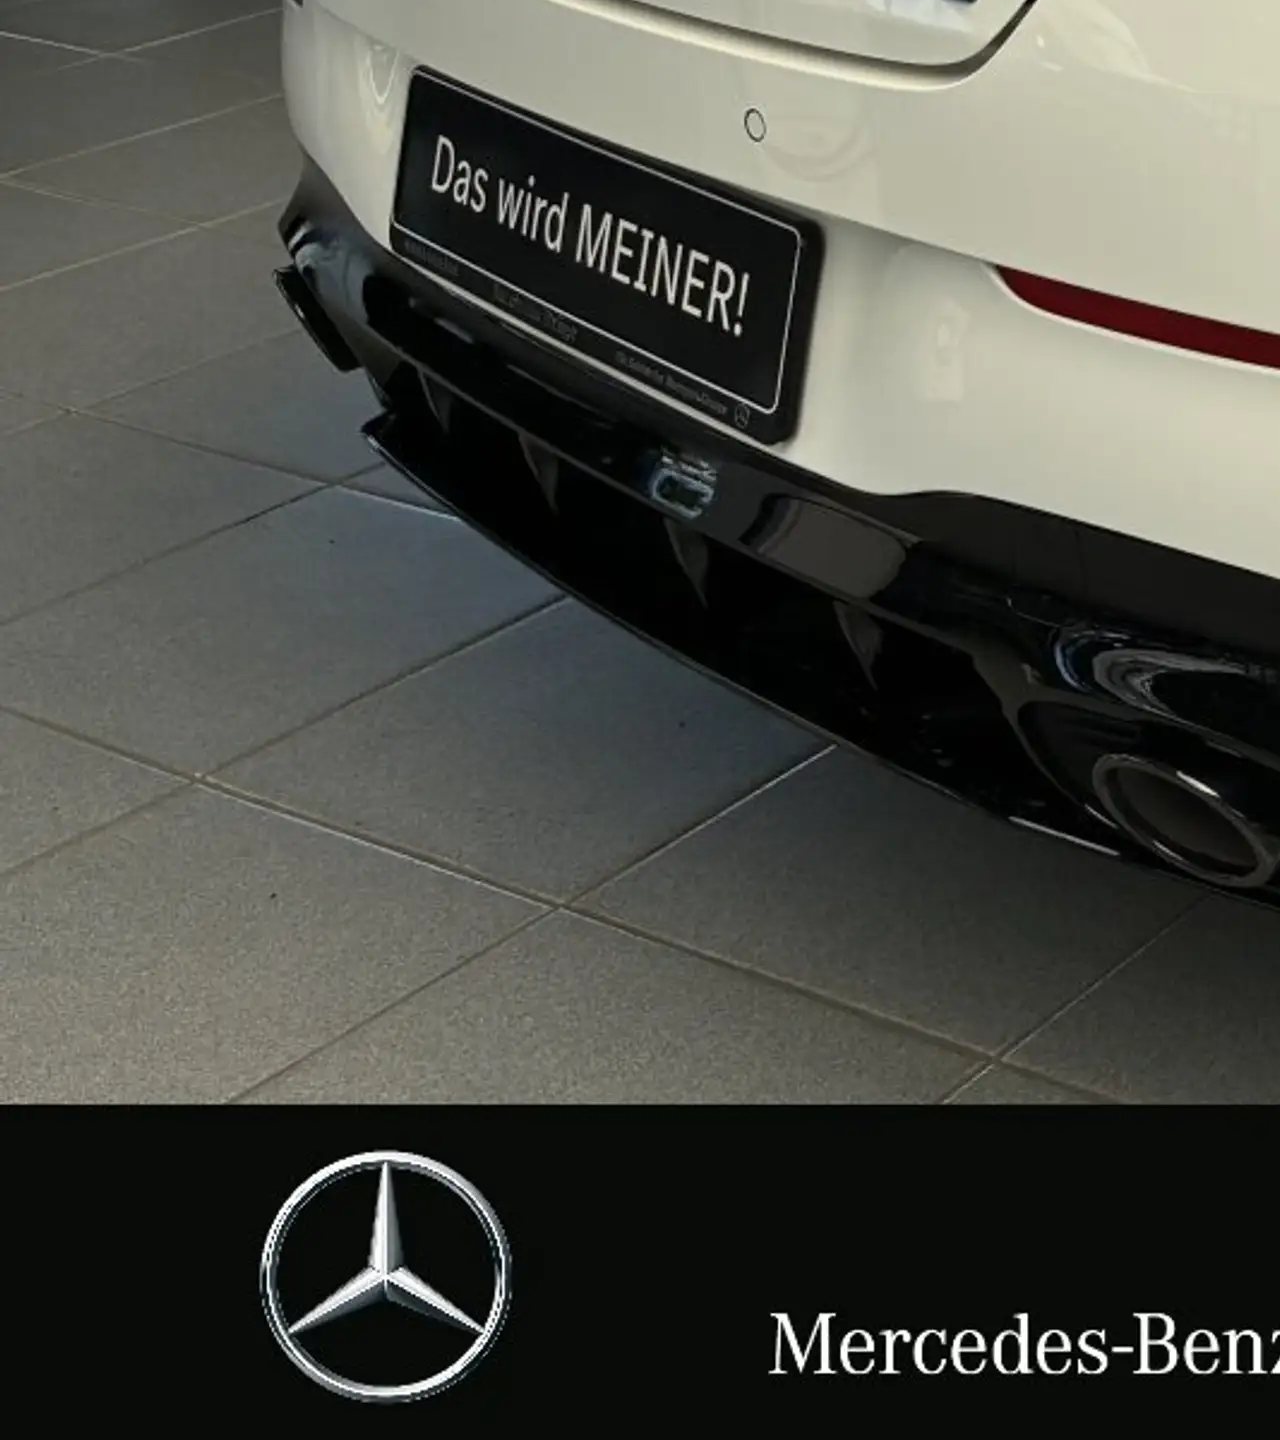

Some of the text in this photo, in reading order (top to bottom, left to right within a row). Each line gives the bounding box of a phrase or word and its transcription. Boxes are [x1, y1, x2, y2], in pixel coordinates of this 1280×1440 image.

[431, 134, 489, 213] Das
[498, 175, 570, 253] wird
[575, 203, 751, 338] MEINER!
